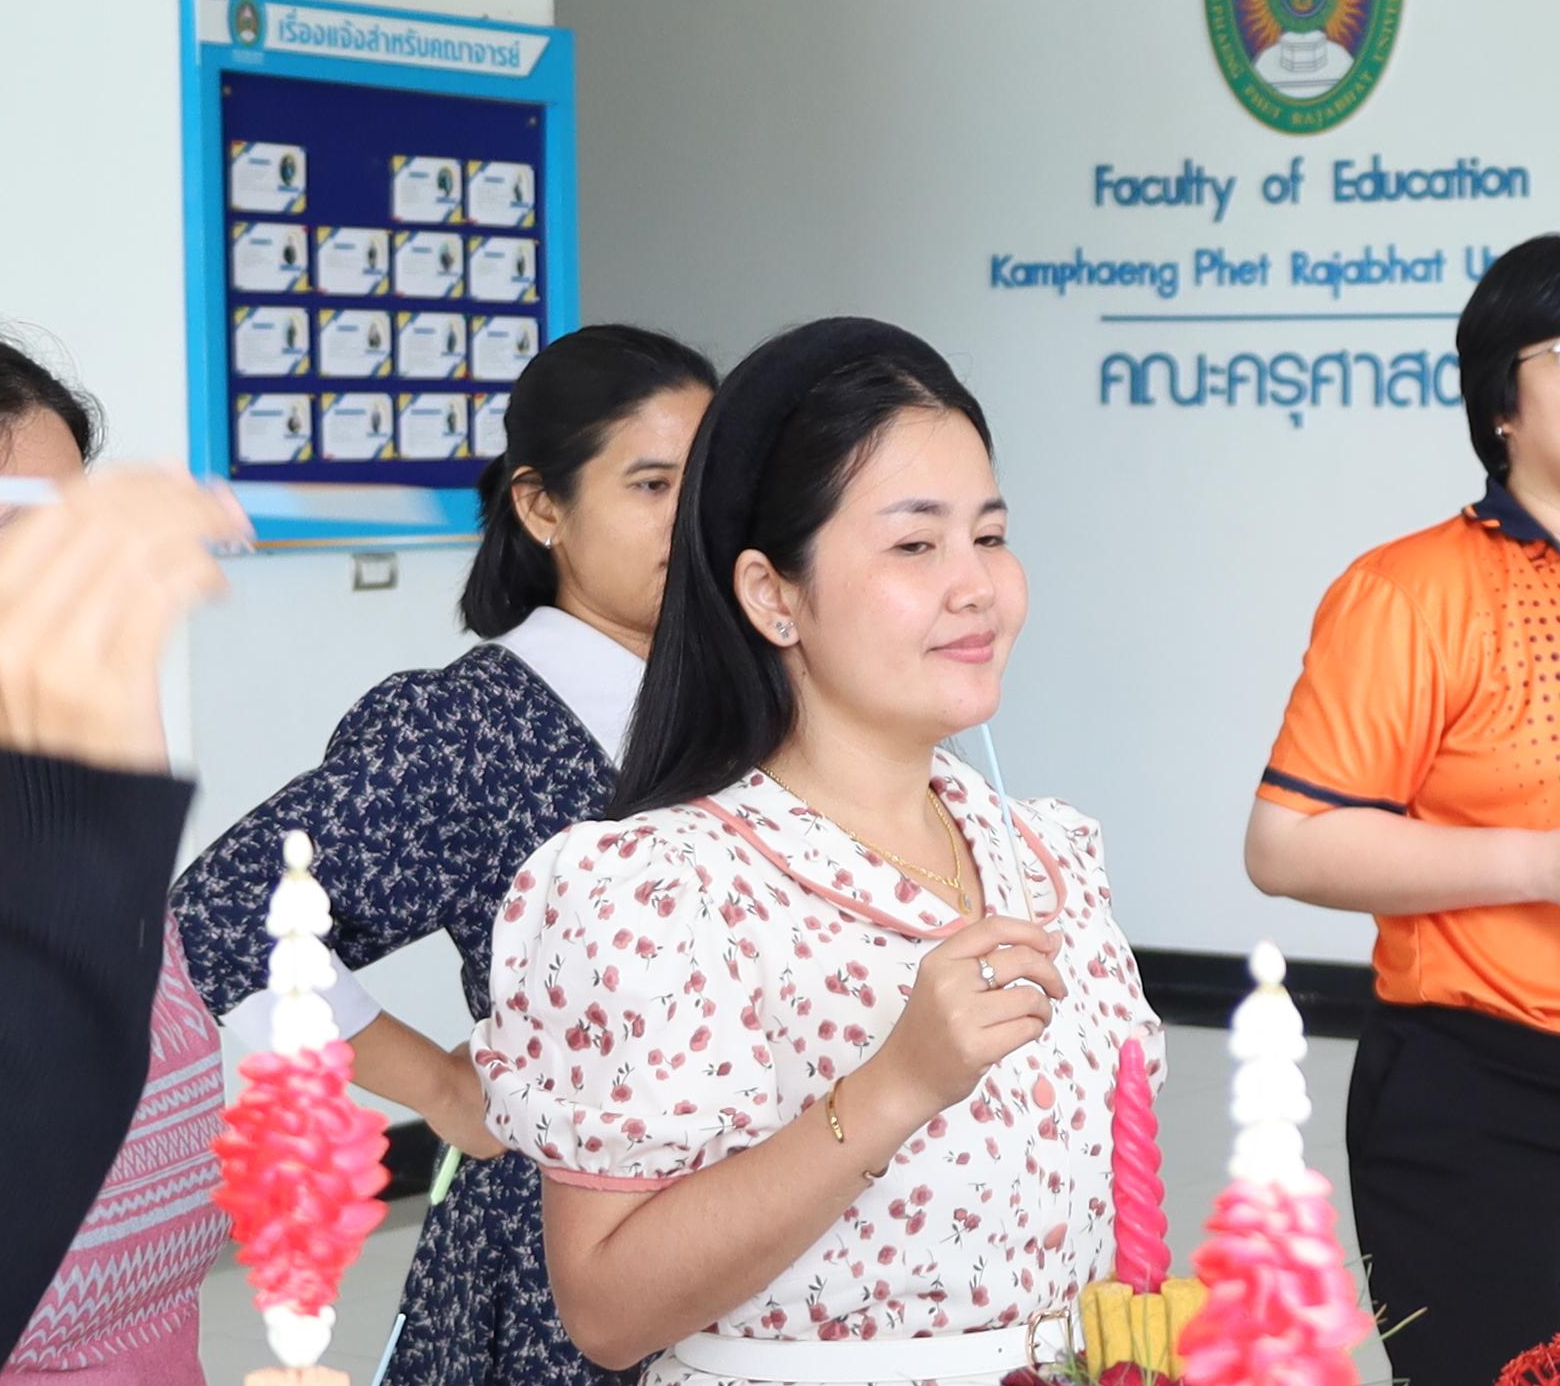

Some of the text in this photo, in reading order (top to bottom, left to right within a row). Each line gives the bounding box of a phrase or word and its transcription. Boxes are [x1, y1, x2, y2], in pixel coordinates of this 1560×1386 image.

[1094, 154, 1529, 223] Faculty of Education
[990, 247, 1180, 299] Kamphaeng
[1194, 249, 1271, 289] Phet
[1290, 244, 1446, 299] Rajabhat
